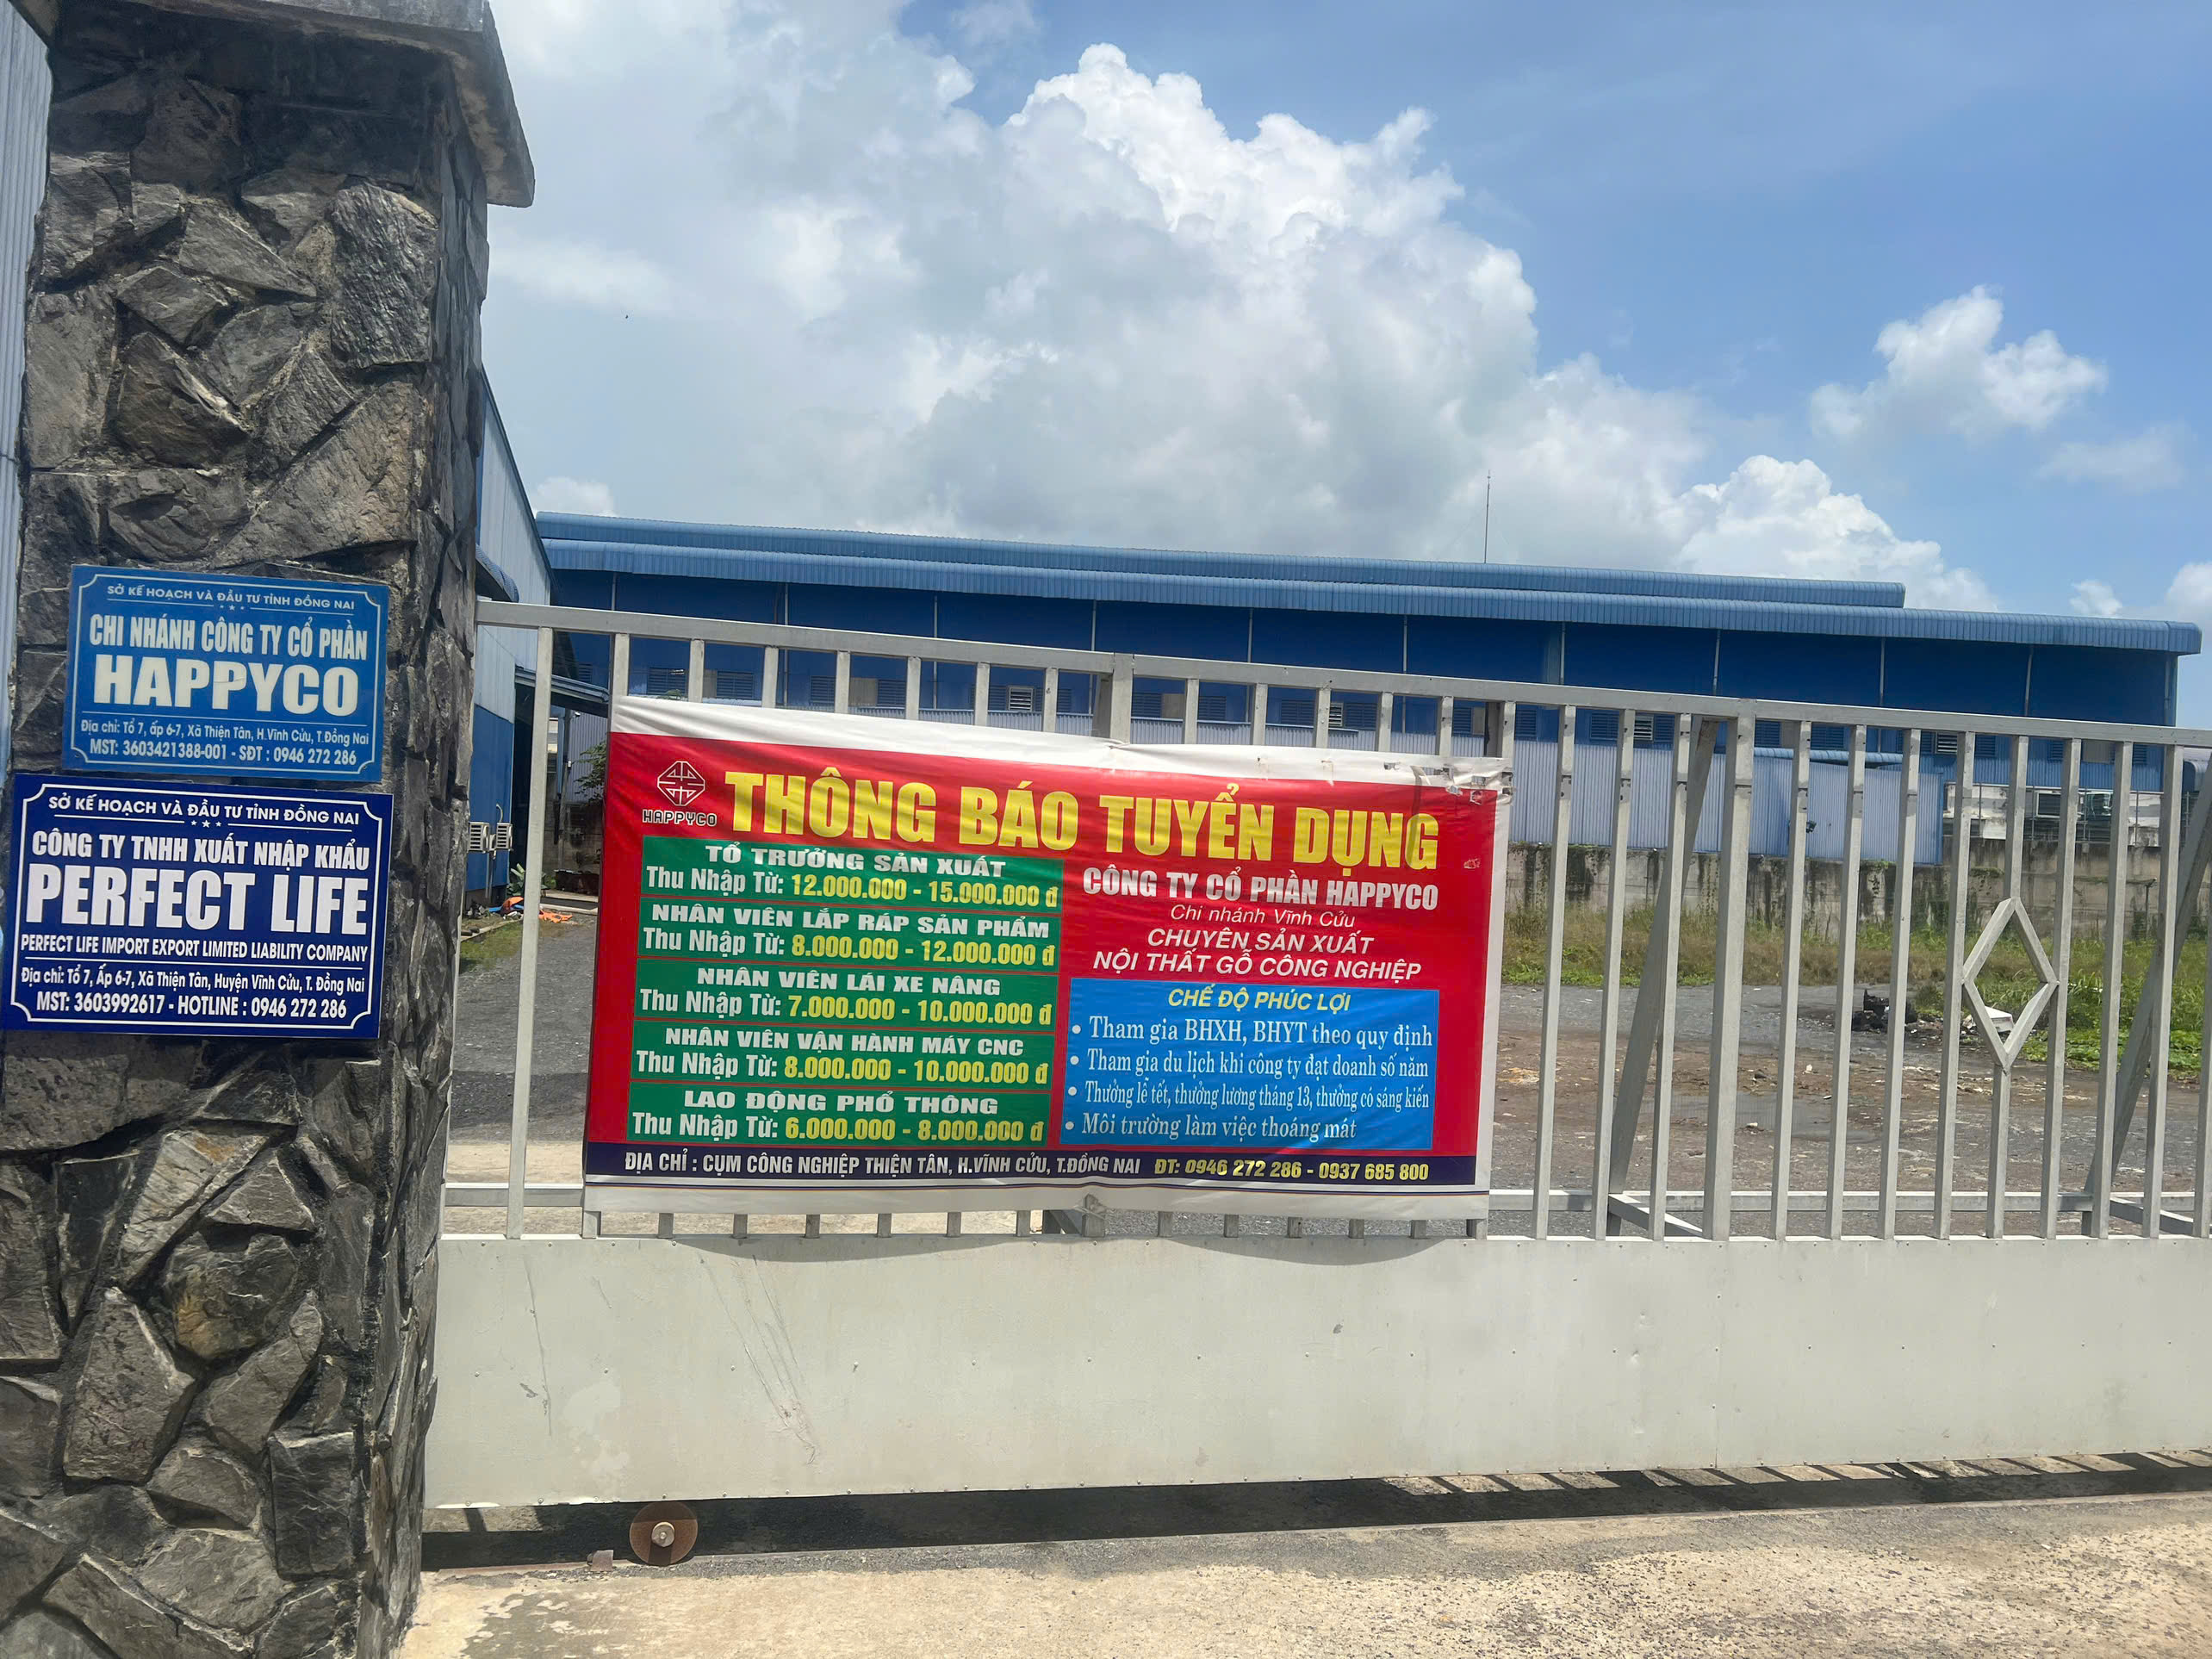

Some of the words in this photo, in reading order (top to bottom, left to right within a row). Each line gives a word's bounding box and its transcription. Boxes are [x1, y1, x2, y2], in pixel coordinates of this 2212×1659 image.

[90, 614, 124, 646] CHI
[129, 613, 196, 650] NHÁNH
[201, 616, 253, 655] CÔNG
[259, 624, 283, 656] TY
[287, 616, 314, 658] CỔ
[318, 619, 368, 661] PHẦN
[93, 654, 359, 717] HAPPYCO
[81, 719, 99, 736] Địa
[101, 718, 121, 734] chỉ:
[123, 718, 135, 734] Tổ
[138, 723, 147, 736] 7,
[149, 720, 164, 737] ấp
[166, 724, 184, 738] 6-7,
[187, 724, 202, 737] Xã
[204, 724, 231, 741] Thiện
[233, 726, 254, 742] Tân,
[291, 728, 314, 744] Cửu,
[352, 732, 370, 745] Nai
[90, 738, 119, 755] MST:
[122, 739, 227, 760] 3603421388-001
[239, 745, 263, 761] SĐT
[273, 747, 304, 763] 0946
[308, 749, 331, 765] 272
[333, 749, 357, 766] 286
[48, 792, 71, 810] SỞ
[75, 793, 97, 811] KẾ
[98, 798, 157, 817] HOẠCH
[161, 799, 183, 816] VÀ
[187, 798, 220, 817] ĐẦU
[224, 805, 243, 817] TƯ
[245, 803, 279, 821] TỈNH
[283, 804, 330, 823] ĐỒNG
[333, 811, 359, 825] NAI
[641, 809, 718, 827] HAPPYCO
[724, 766, 937, 843] THÔNG
[959, 780, 1078, 851] BÁO
[1099, 783, 1276, 862] TUYỂN
[1293, 806, 1439, 879] DỤNG
[32, 828, 92, 858] CÔNG
[98, 834, 126, 859] TY
[131, 836, 188, 862] TNHH
[193, 832, 248, 865] XUẤT
[253, 839, 309, 872] NHẬP
[314, 838, 370, 871] KHẨU
[705, 841, 742, 864] TỔ
[750, 848, 864, 871] TRƯỞNG
[873, 852, 928, 874] SẢN
[936, 855, 1006, 878] XUẤT
[26, 863, 256, 930] PERFECT
[270, 873, 369, 935] LIFE
[646, 865, 684, 890] Thu
[691, 867, 746, 897] Nhập
[753, 871, 784, 894] Từ:
[792, 874, 907, 901] 12.000.000
[929, 880, 1040, 907] 15.000.000
[1046, 885, 1059, 908] đ
[1083, 864, 1158, 898] CÔNG
[1166, 872, 1199, 898] TY
[1206, 866, 1242, 901] CỔ
[1250, 869, 1319, 905] PHẦN
[1326, 879, 1438, 910] HAPPYCO
[1171, 904, 1202, 921] Chi
[1209, 906, 1265, 923] nhánh
[1274, 909, 1312, 925] Vĩnh
[1320, 910, 1355, 928] Cửu
[21, 934, 73, 953] PERFECT
[76, 935, 99, 954] LIFE
[102, 936, 150, 955] IMPORT
[152, 938, 200, 957] EXPORT
[202, 941, 248, 959] LIMITED
[251, 941, 303, 960] LIABILITY
[306, 944, 369, 962] COMPANY
[1147, 927, 1250, 950] CHUYÊN
[1255, 928, 1306, 952] SẢN
[1309, 930, 1374, 954] XUẤT
[21, 966, 40, 988] Địa
[43, 966, 65, 985] chỉ:
[67, 964, 81, 985] Tổ
[84, 968, 94, 988] 7,
[96, 963, 113, 989] Ấp
[115, 970, 135, 989] 6-7,
[138, 971, 154, 987] Xã
[157, 971, 186, 991] Thiện
[189, 971, 212, 991] Tân,
[214, 972, 248, 993] Huyện
[252, 974, 275, 990] Vĩnh
[277, 972, 302, 993] Cửu,
[316, 972, 344, 997] Đồng
[346, 977, 365, 992] Nai
[1093, 948, 1139, 973] NỘI
[1146, 948, 1211, 972] THẤT
[1215, 948, 1253, 975] GỖ
[1259, 954, 1329, 978] CÔNG
[1334, 958, 1421, 984] NGHIỆP
[36, 991, 70, 1011] MST:
[73, 992, 165, 1015] 3603992617
[177, 995, 239, 1016] HOTLINE
[251, 997, 287, 1017] 0946
[290, 998, 317, 1018] 272
[320, 999, 347, 1019] 286
[1168, 983, 1216, 1007] CHẾ
[1218, 987, 1249, 1012] ĐỘ
[1254, 989, 1313, 1010] PHÚC
[1317, 992, 1351, 1015] LỢI
[1089, 1016, 1145, 1040] Tham
[1149, 1017, 1178, 1045] gia
[1184, 1018, 1247, 1047] BHXH,
[1253, 1020, 1308, 1044] BHYT
[1312, 1022, 1351, 1045] theo
[1356, 1030, 1389, 1050] quy
[1393, 1024, 1433, 1052] định
[1088, 1047, 1131, 1072] Tham
[1135, 1050, 1159, 1076] gia
[1164, 1050, 1183, 1072] du
[1188, 1051, 1215, 1079] lịch
[1220, 1052, 1244, 1074] khi
[1248, 1052, 1283, 1080] công
[1287, 1056, 1302, 1079] ty
[1305, 1053, 1329, 1081] đạt
[1333, 1054, 1376, 1076] doanh
[1380, 1053, 1398, 1077] số
[1399, 1056, 1429, 1077] năm
[1082, 1112, 1115, 1134] Môi
[1121, 1113, 1181, 1140] trường
[1185, 1114, 1217, 1136] làm
[1221, 1115, 1257, 1143] việc
[1262, 1115, 1321, 1143] thoáng
[1324, 1118, 1357, 1139] mát
[624, 1153, 653, 1174] ĐỊA
[659, 1147, 688, 1171] CHỈ
[703, 1154, 741, 1177] CỤM
[747, 1153, 792, 1174] CÔNG
[798, 1153, 860, 1177] NGHIỆP
[865, 1154, 912, 1177] THIỆN
[917, 1153, 953, 1176] TÂN,
[1016, 1152, 1051, 1175] CỬU,
[1113, 1158, 1140, 1174] NAI
[1155, 1159, 1180, 1174] ĐT:
[1185, 1159, 1227, 1176] 0946
[1233, 1159, 1266, 1177] 272
[1270, 1162, 1302, 1178] 286
[1319, 1163, 1360, 1180] 0937
[1364, 1164, 1395, 1180] 685
[1399, 1164, 1429, 1181] 800
